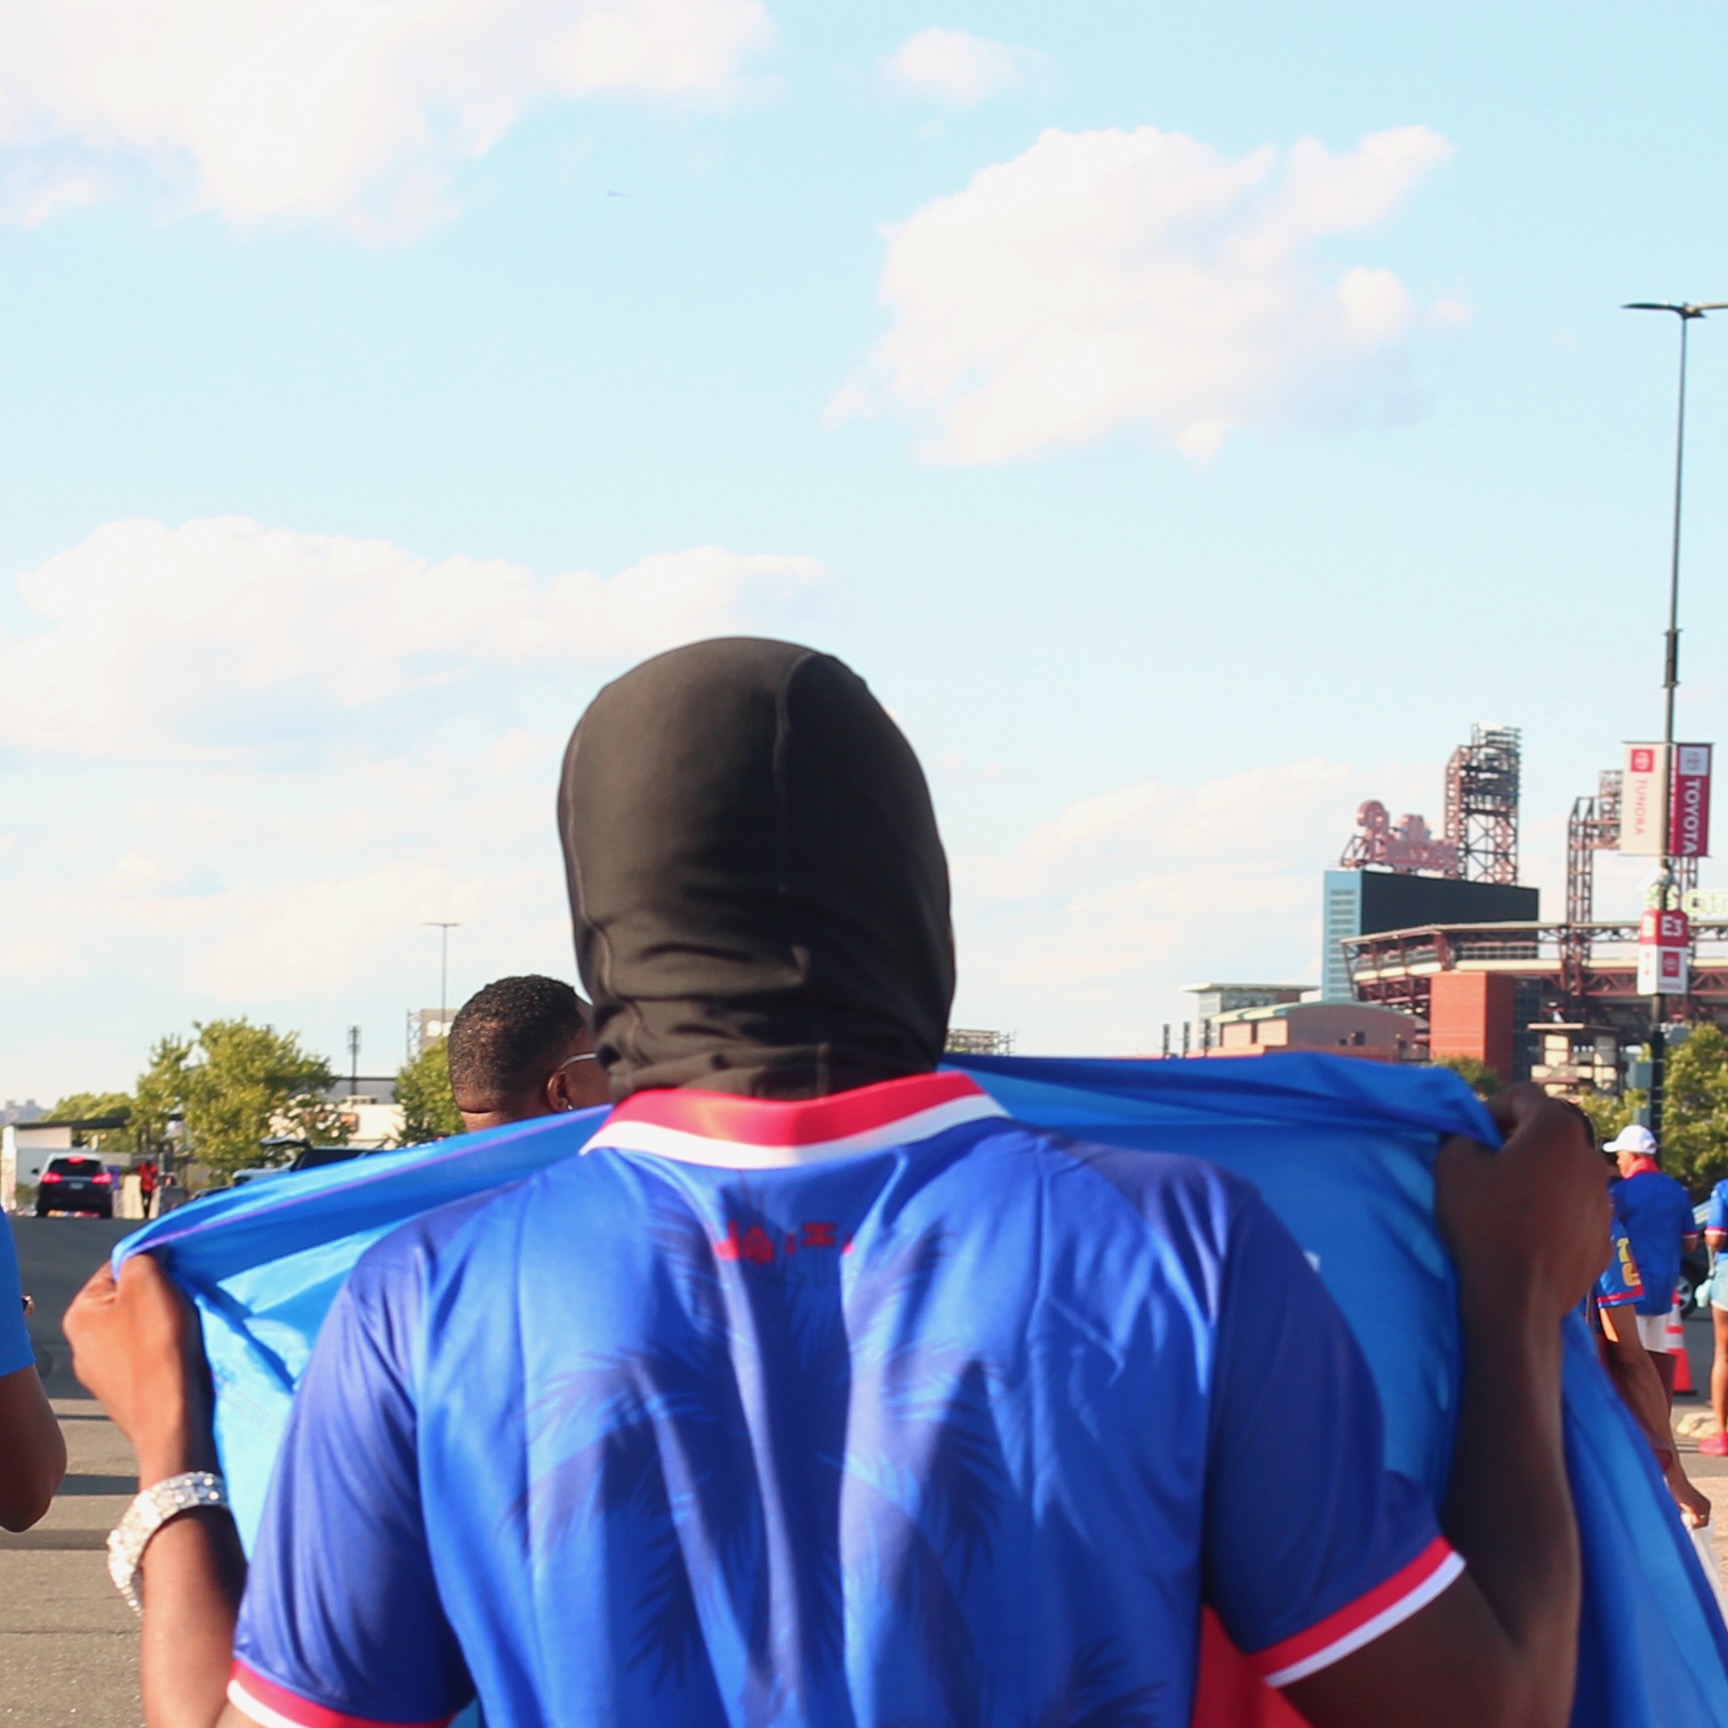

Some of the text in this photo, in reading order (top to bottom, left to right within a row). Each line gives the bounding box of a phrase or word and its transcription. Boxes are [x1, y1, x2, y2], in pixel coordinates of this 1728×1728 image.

[1634, 779, 1648, 837] TUNDRA
[1682, 779, 1701, 855] TOYOTA
[1661, 915, 1683, 937] E3
